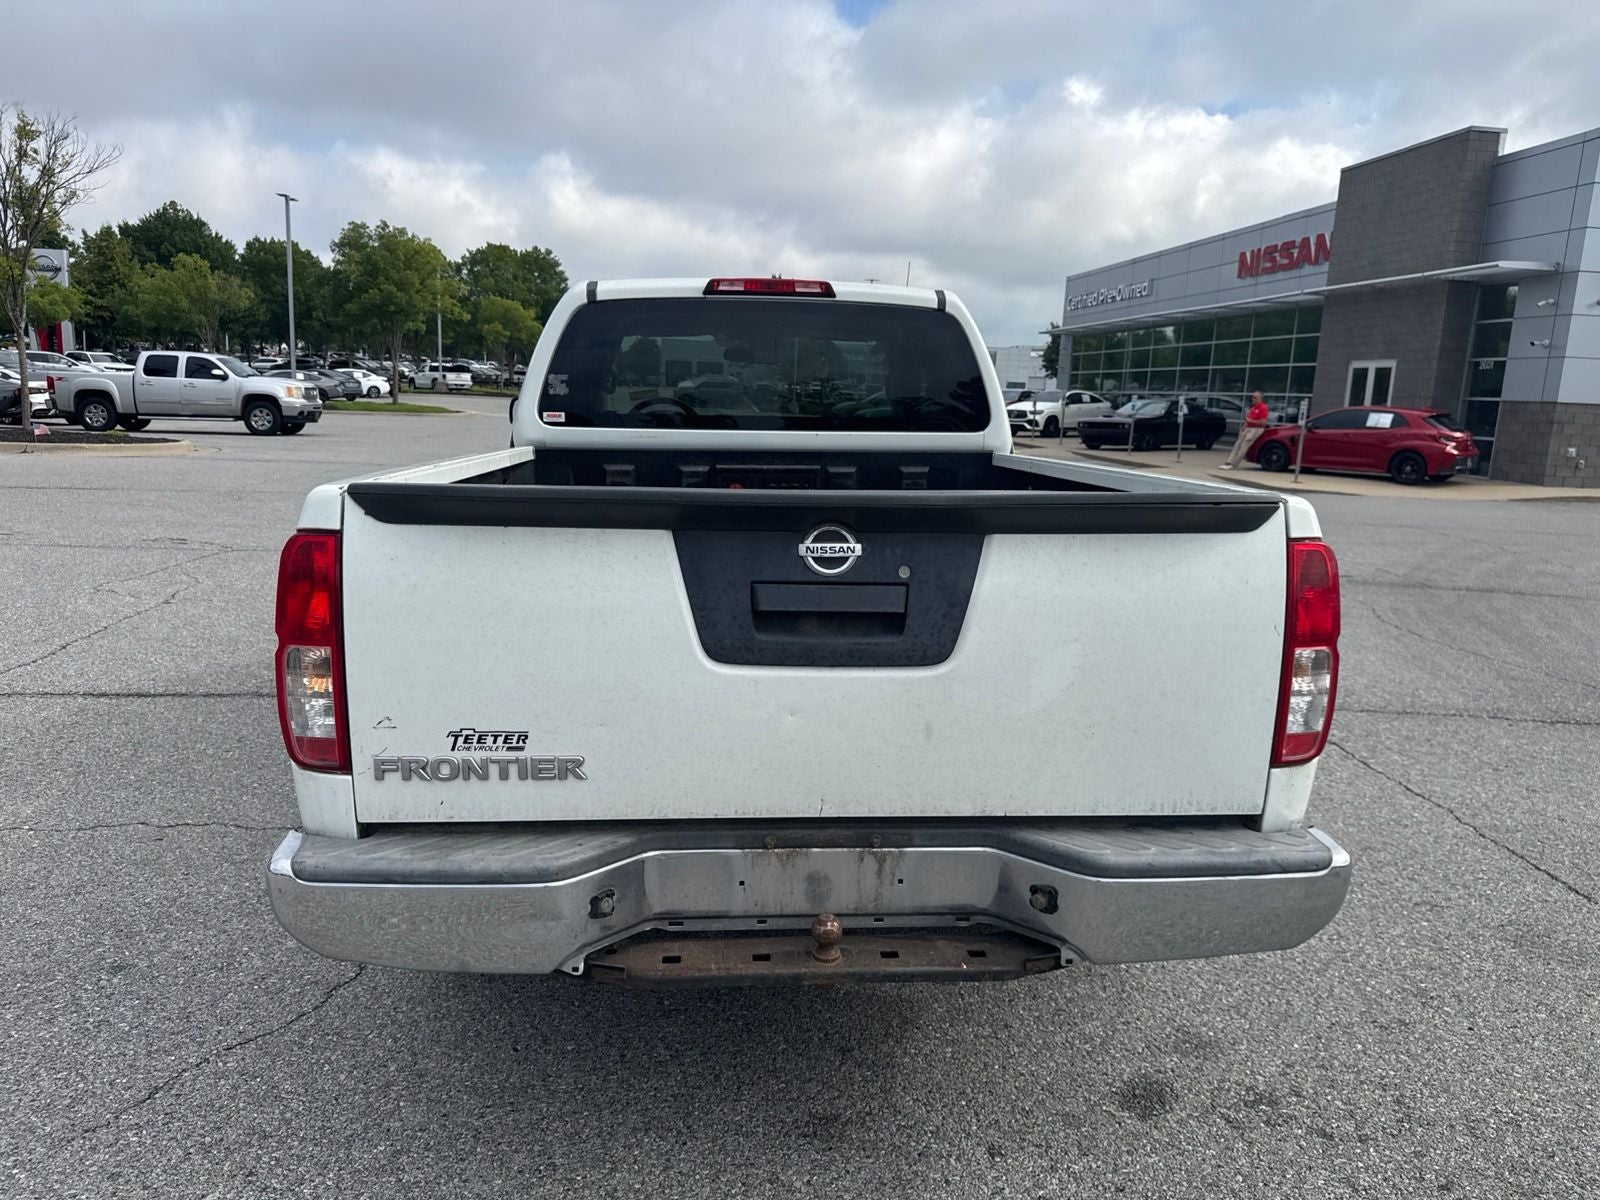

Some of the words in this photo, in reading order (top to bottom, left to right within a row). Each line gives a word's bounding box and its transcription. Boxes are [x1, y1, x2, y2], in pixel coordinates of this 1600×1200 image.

[1237, 233, 1330, 278] NISSAN
[1066, 289, 1098, 311] Certified
[1099, 278, 1148, 303] Pre-Owned
[805, 546, 855, 555] NISSAN
[450, 733, 529, 752] TEETER
[373, 755, 588, 782] FRONTIER
